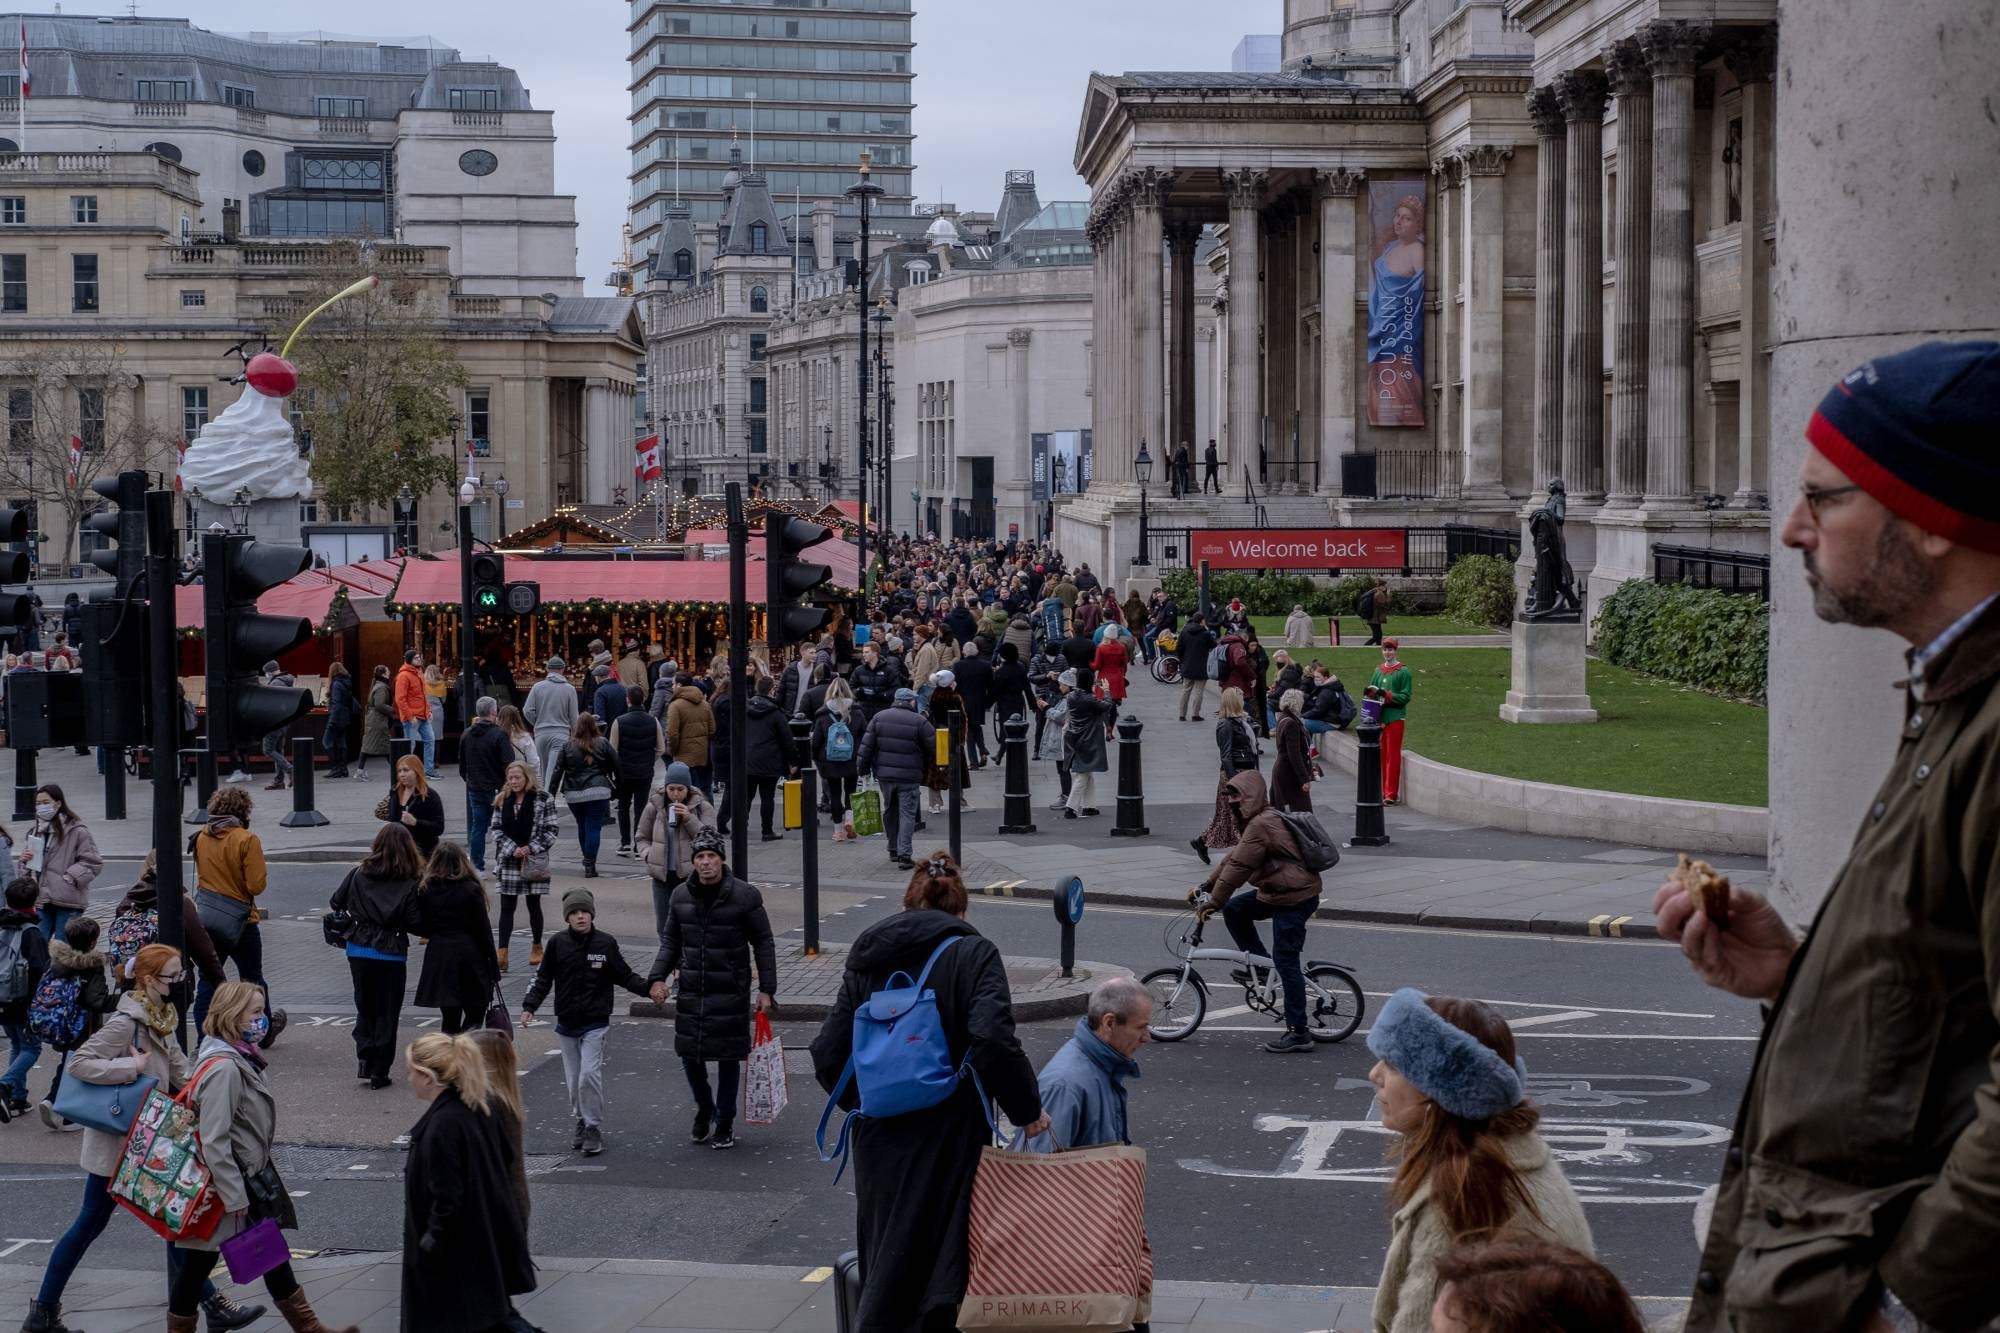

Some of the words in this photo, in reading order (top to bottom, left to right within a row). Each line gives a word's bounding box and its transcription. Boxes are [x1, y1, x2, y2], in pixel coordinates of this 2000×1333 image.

[1400, 296, 1413, 341] Dance
[1380, 296, 1397, 399] POUSSIN
[1400, 344, 1413, 365] the
[1229, 539, 1318, 558] Welcome
[1324, 539, 1368, 558] back
[587, 953, 607, 962] NASA
[982, 1300, 1085, 1317] PRIMARK
